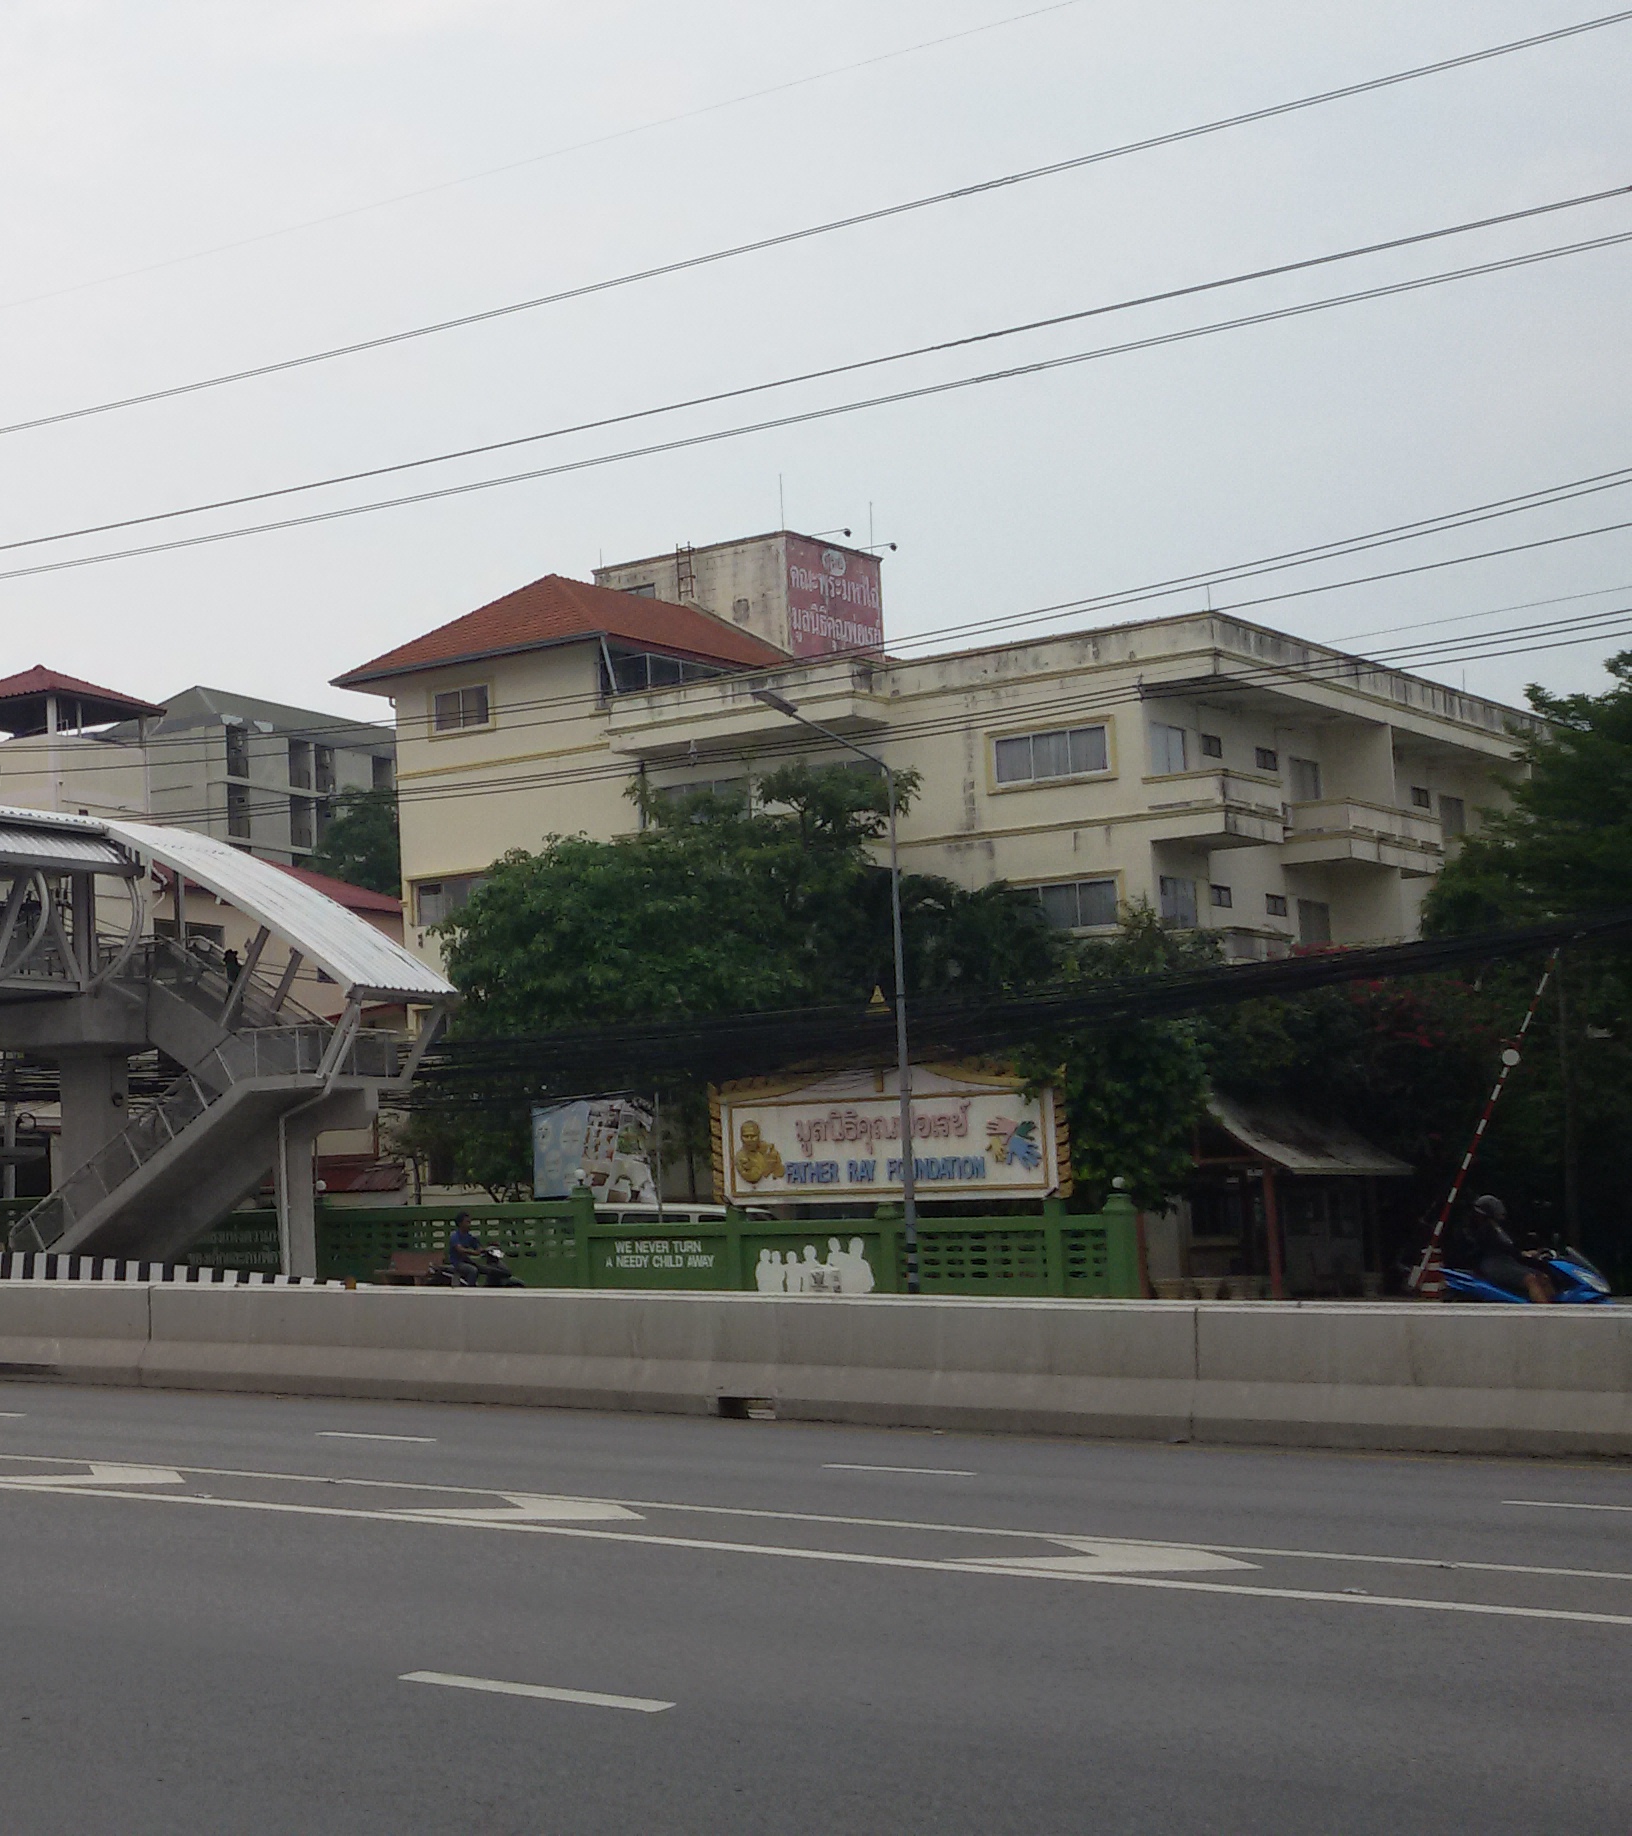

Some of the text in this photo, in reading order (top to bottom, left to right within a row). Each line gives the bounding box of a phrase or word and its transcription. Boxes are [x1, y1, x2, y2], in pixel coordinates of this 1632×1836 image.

[785, 1160, 840, 1184] FATHER
[847, 1159, 877, 1183] RAY
[614, 1240, 703, 1254] WE NEVER TURN
[605, 1254, 716, 1268] A NEEDY CHILD AWAY
